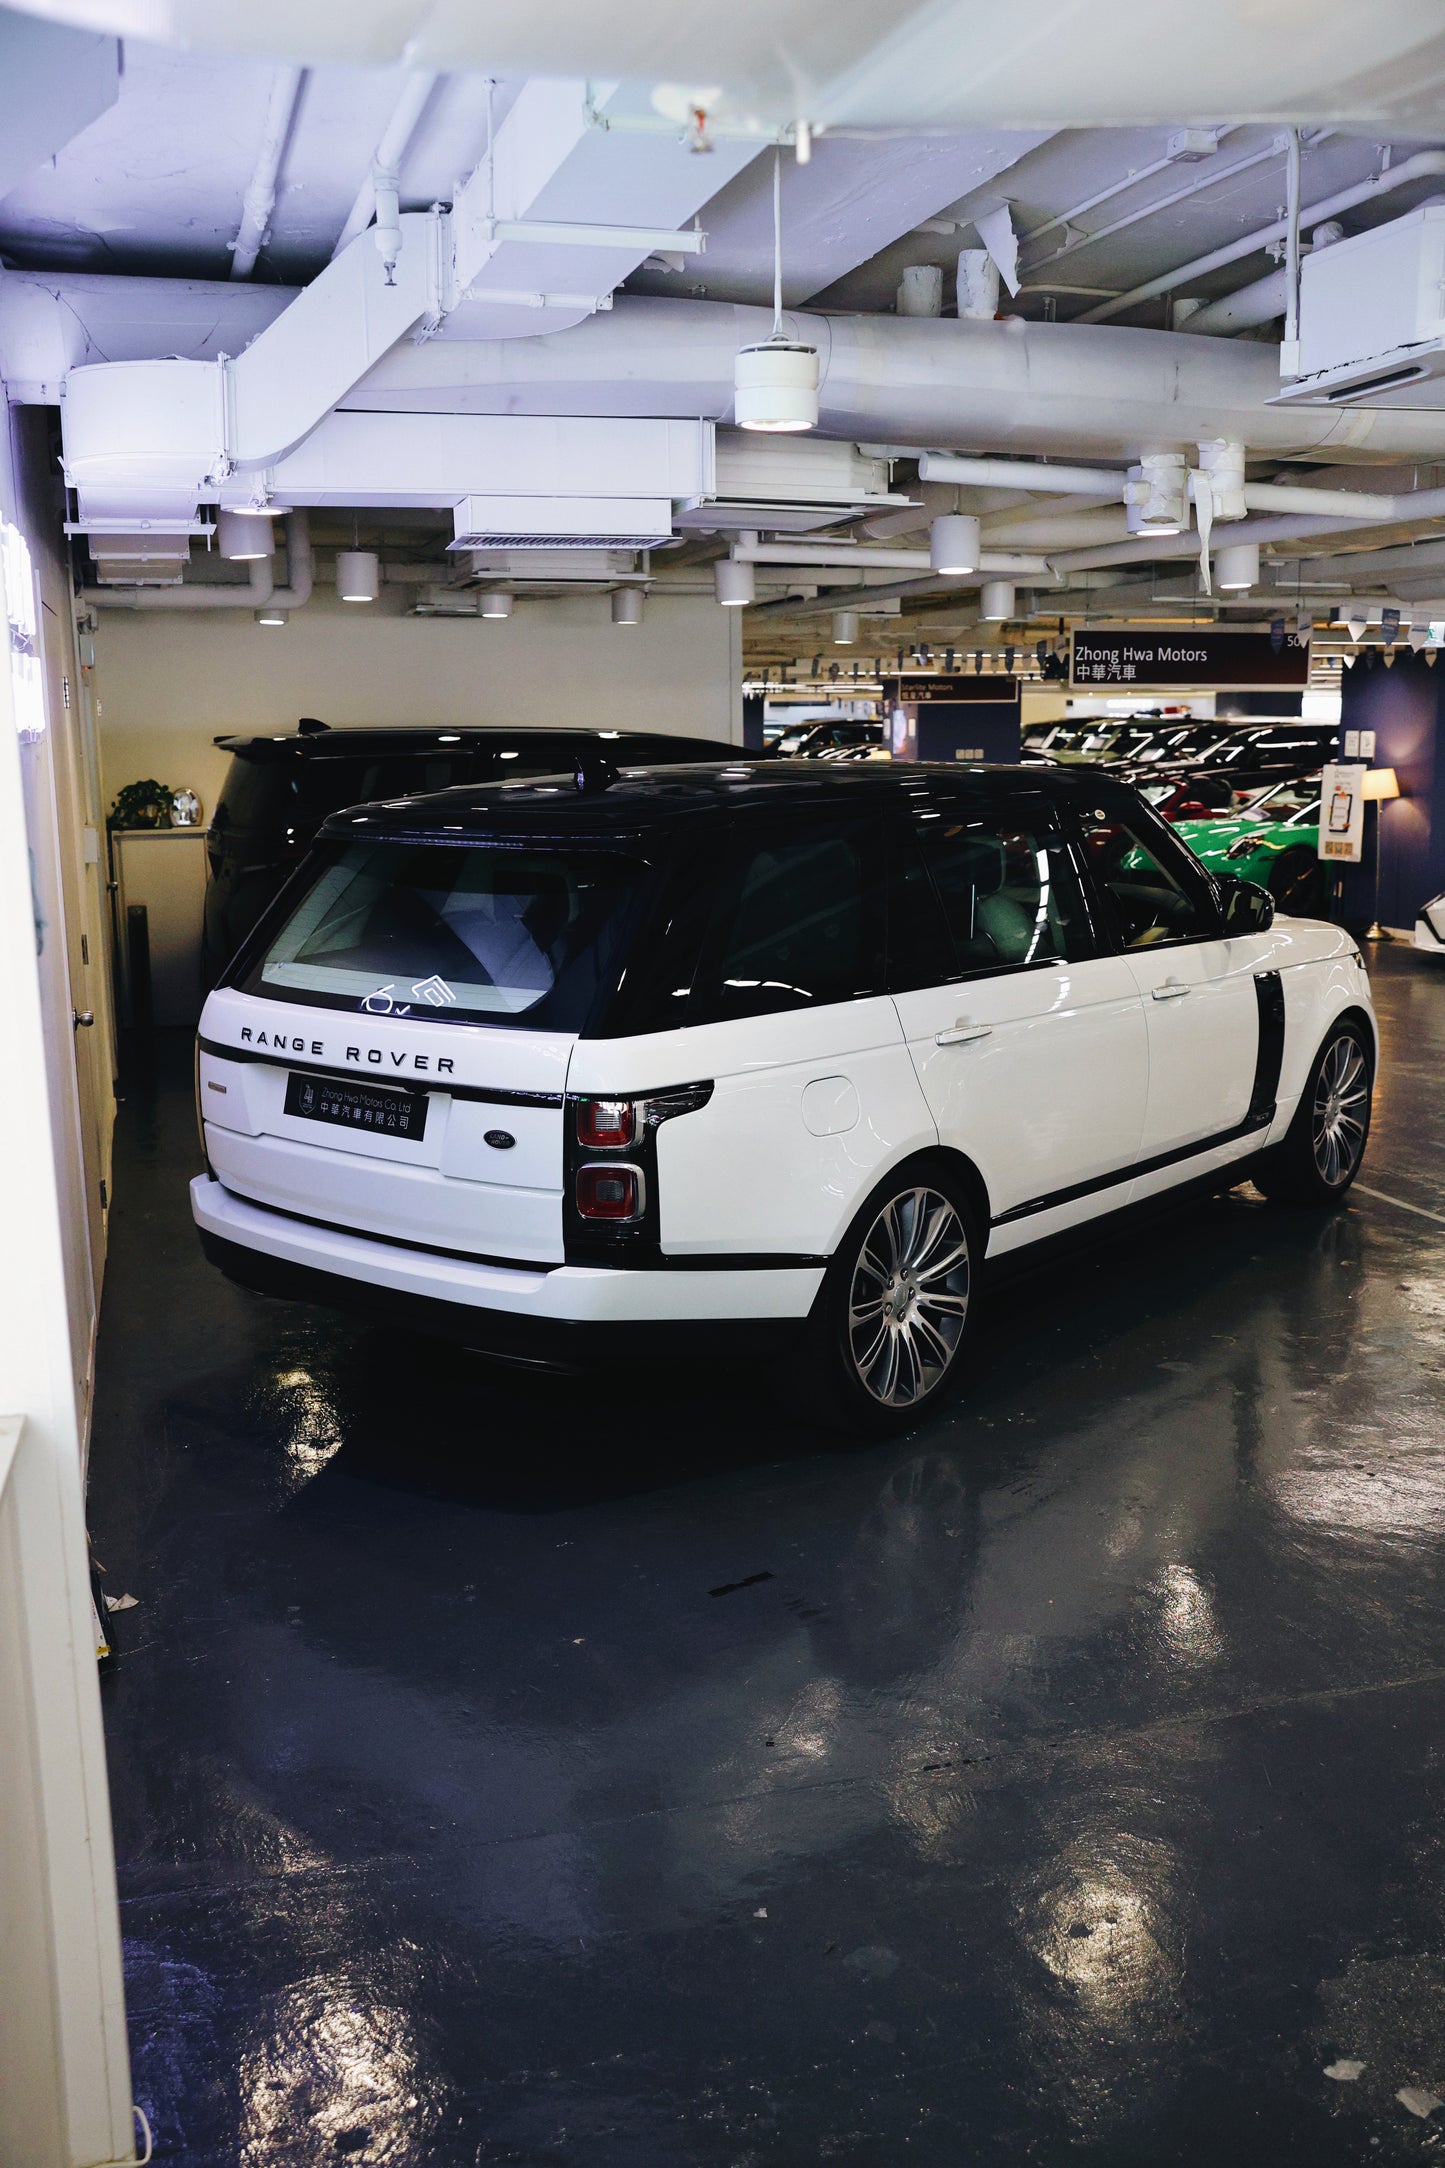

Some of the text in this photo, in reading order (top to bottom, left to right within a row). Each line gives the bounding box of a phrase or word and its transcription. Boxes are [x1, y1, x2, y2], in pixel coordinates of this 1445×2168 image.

[1075, 646, 1207, 663] Zhong Hwa Motors
[1076, 664, 1137, 681] 中華汽車
[928, 683, 953, 691] Motors
[241, 1027, 454, 1074] RANGE ROVER
[321, 1086, 344, 1103] Zhong
[344, 1091, 359, 1104] Hwa
[359, 1093, 383, 1109] Motors
[398, 1102, 412, 1114] Ltd
[320, 1101, 410, 1130] 中華汽車有限公司
